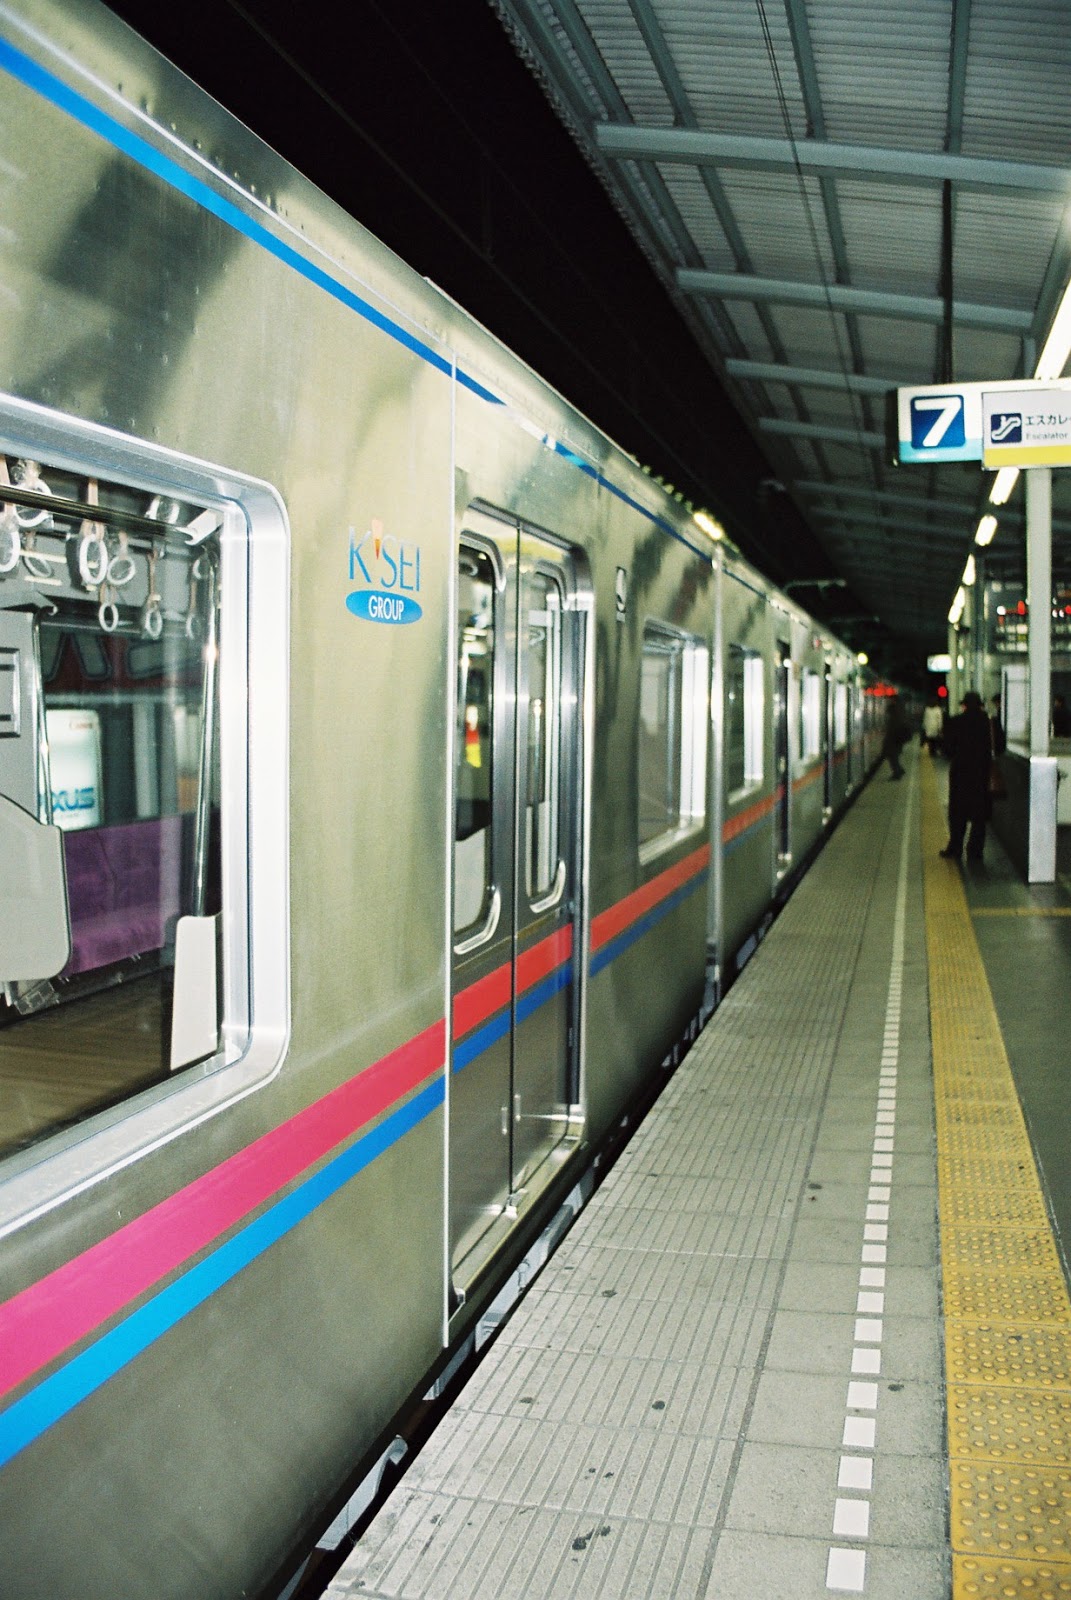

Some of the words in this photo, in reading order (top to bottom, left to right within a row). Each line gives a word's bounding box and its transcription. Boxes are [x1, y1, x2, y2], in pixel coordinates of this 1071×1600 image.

[914, 397, 962, 447] 7
[1025, 414, 1071, 425] エスカレ
[1026, 432, 1067, 440] Escalator
[368, 595, 404, 621] GROUP
